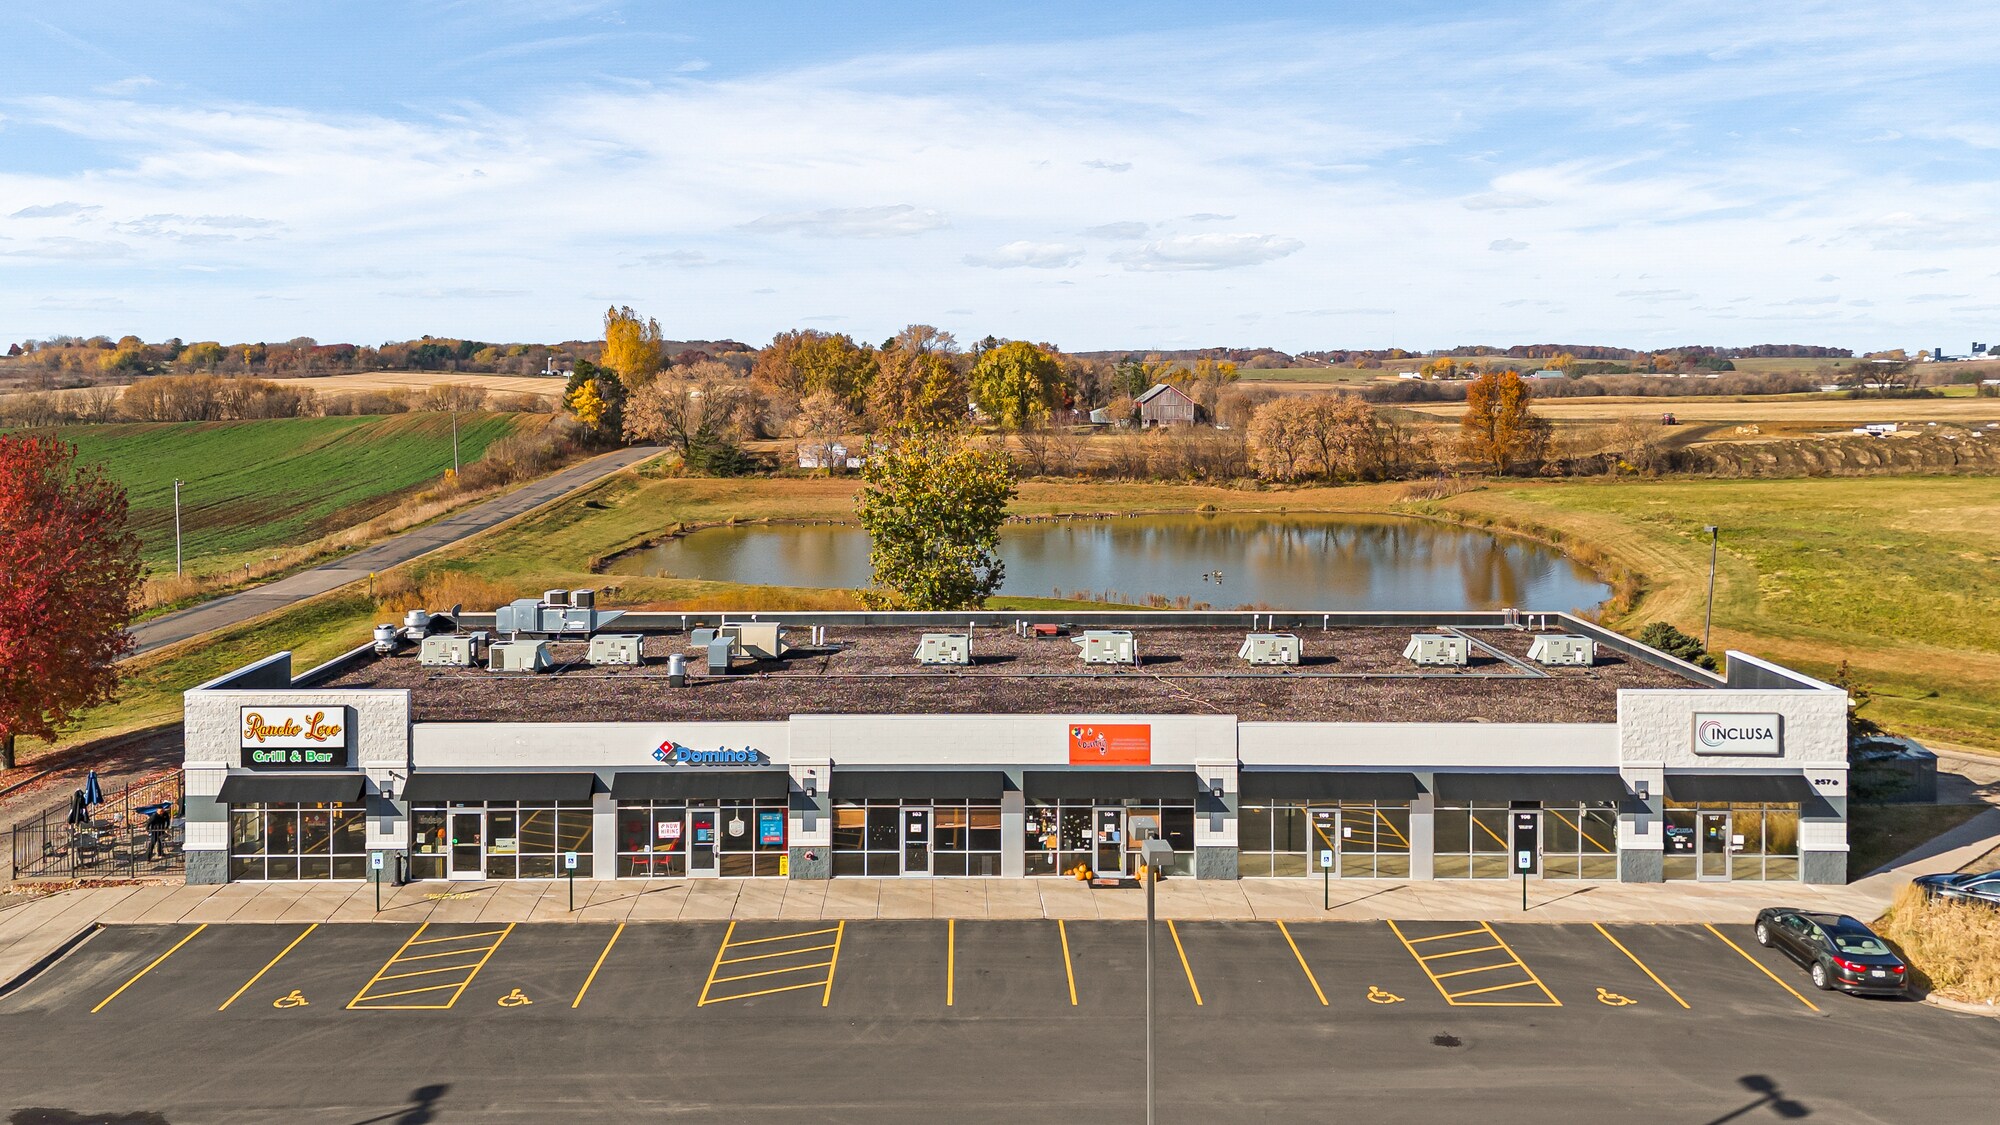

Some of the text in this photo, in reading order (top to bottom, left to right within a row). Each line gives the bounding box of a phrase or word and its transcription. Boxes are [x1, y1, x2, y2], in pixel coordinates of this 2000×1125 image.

[244, 711, 342, 743] Rancho Loco
[1711, 728, 1773, 740] INCLUSA
[253, 750, 332, 762] Grill & Bar
[677, 745, 758, 763] Domino's
